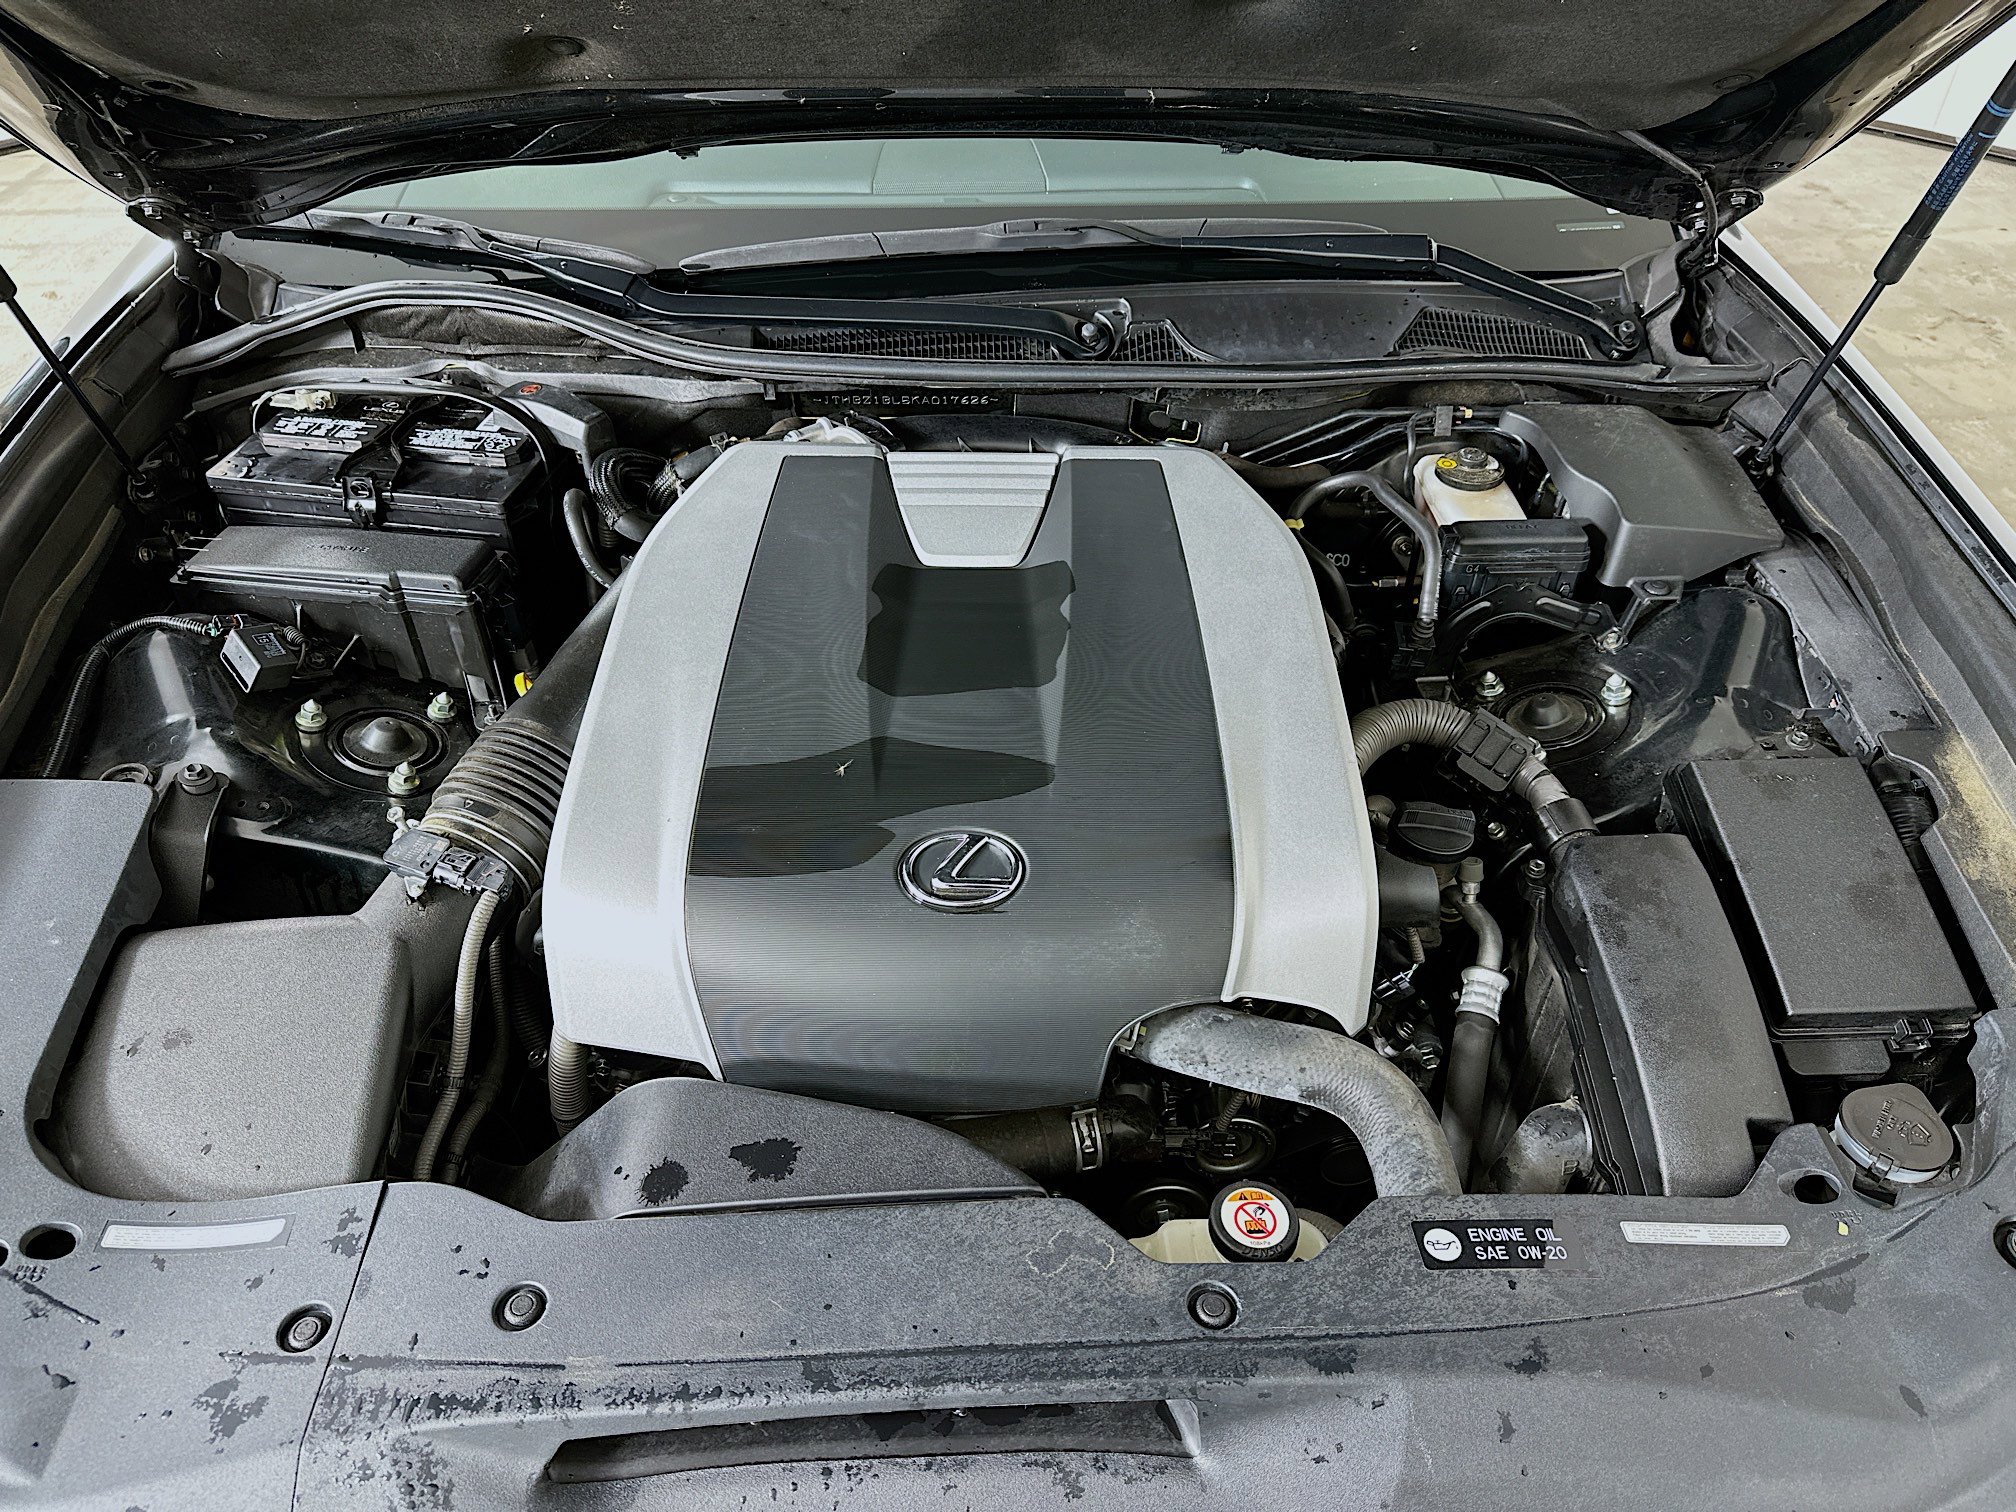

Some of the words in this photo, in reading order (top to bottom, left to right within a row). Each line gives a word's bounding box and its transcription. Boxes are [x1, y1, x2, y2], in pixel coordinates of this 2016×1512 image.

[1467, 1228, 1527, 1242] ENGINE
[1535, 1227, 1562, 1242] OIL
[1475, 1246, 1509, 1260] SAE
[1517, 1245, 1568, 1260] 0W-20
